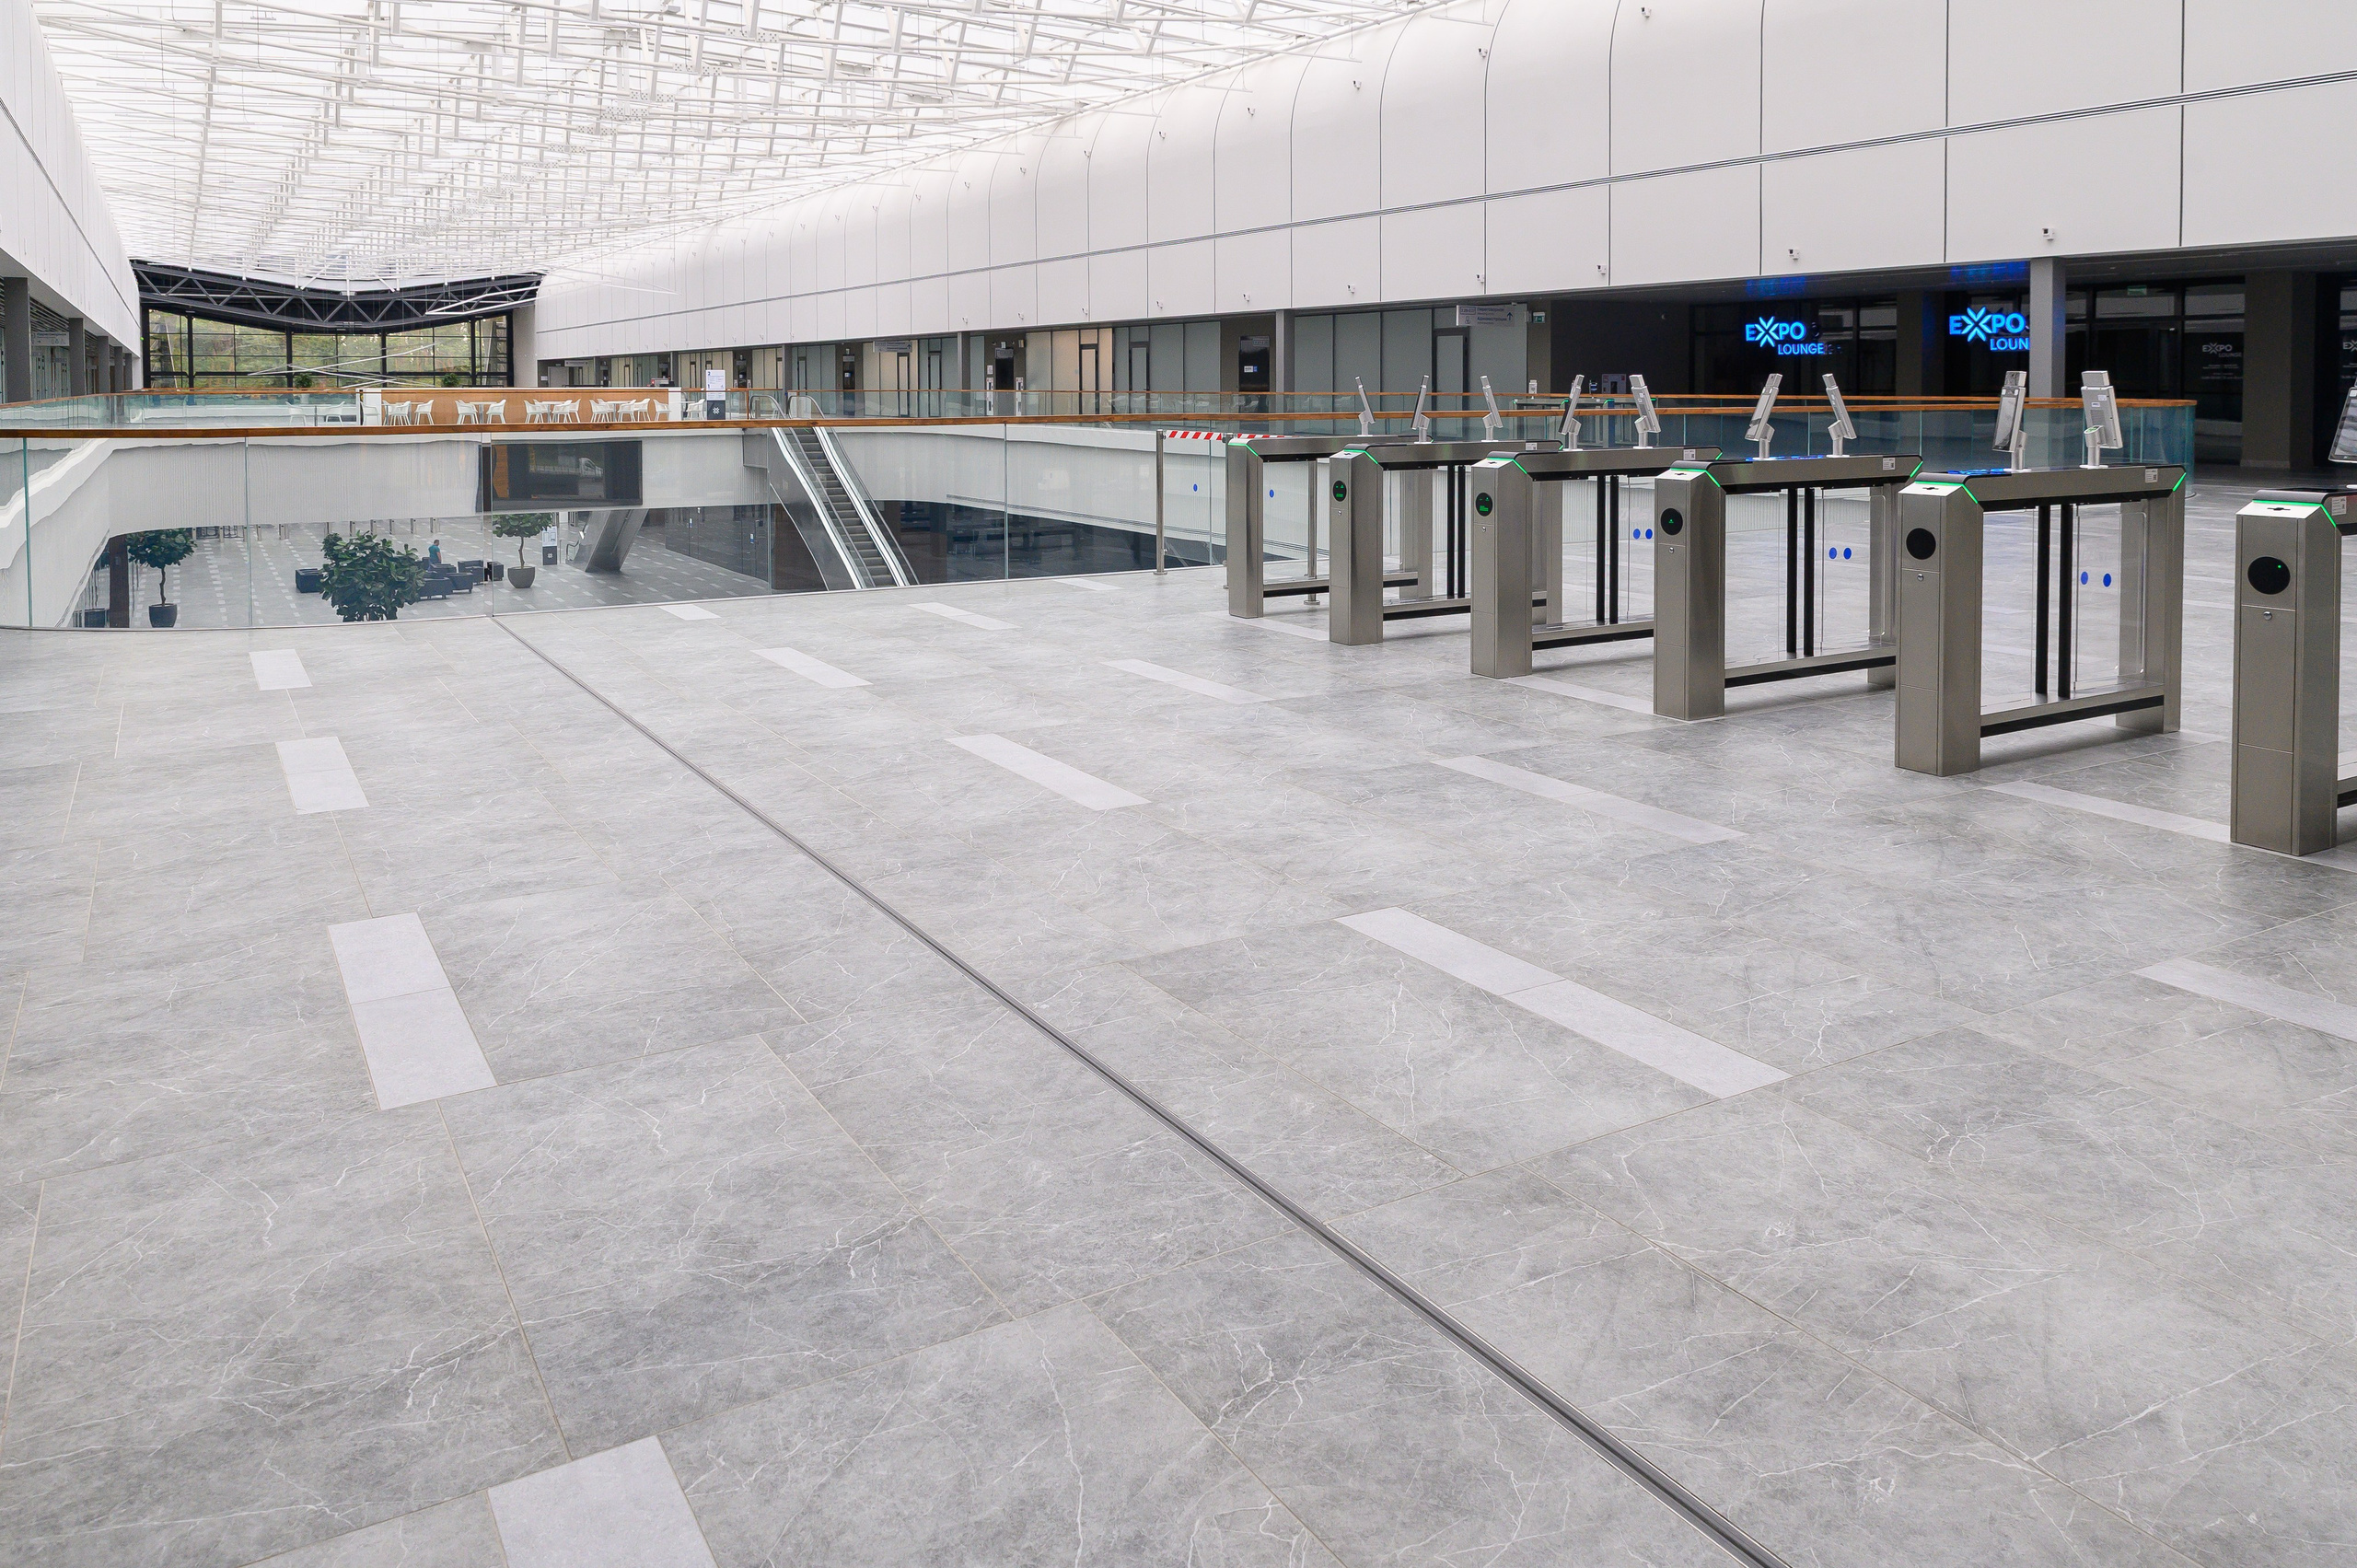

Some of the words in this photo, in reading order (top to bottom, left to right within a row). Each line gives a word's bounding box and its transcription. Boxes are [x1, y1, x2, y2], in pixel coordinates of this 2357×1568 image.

[1949, 306, 2026, 342] EXPO
[1746, 316, 1805, 347] EXPO
[1778, 343, 1824, 354] LOUNGE
[1990, 337, 2030, 351] LOUN
[2202, 343, 2233, 354] EXPO
[2342, 339, 2357, 352] EX
